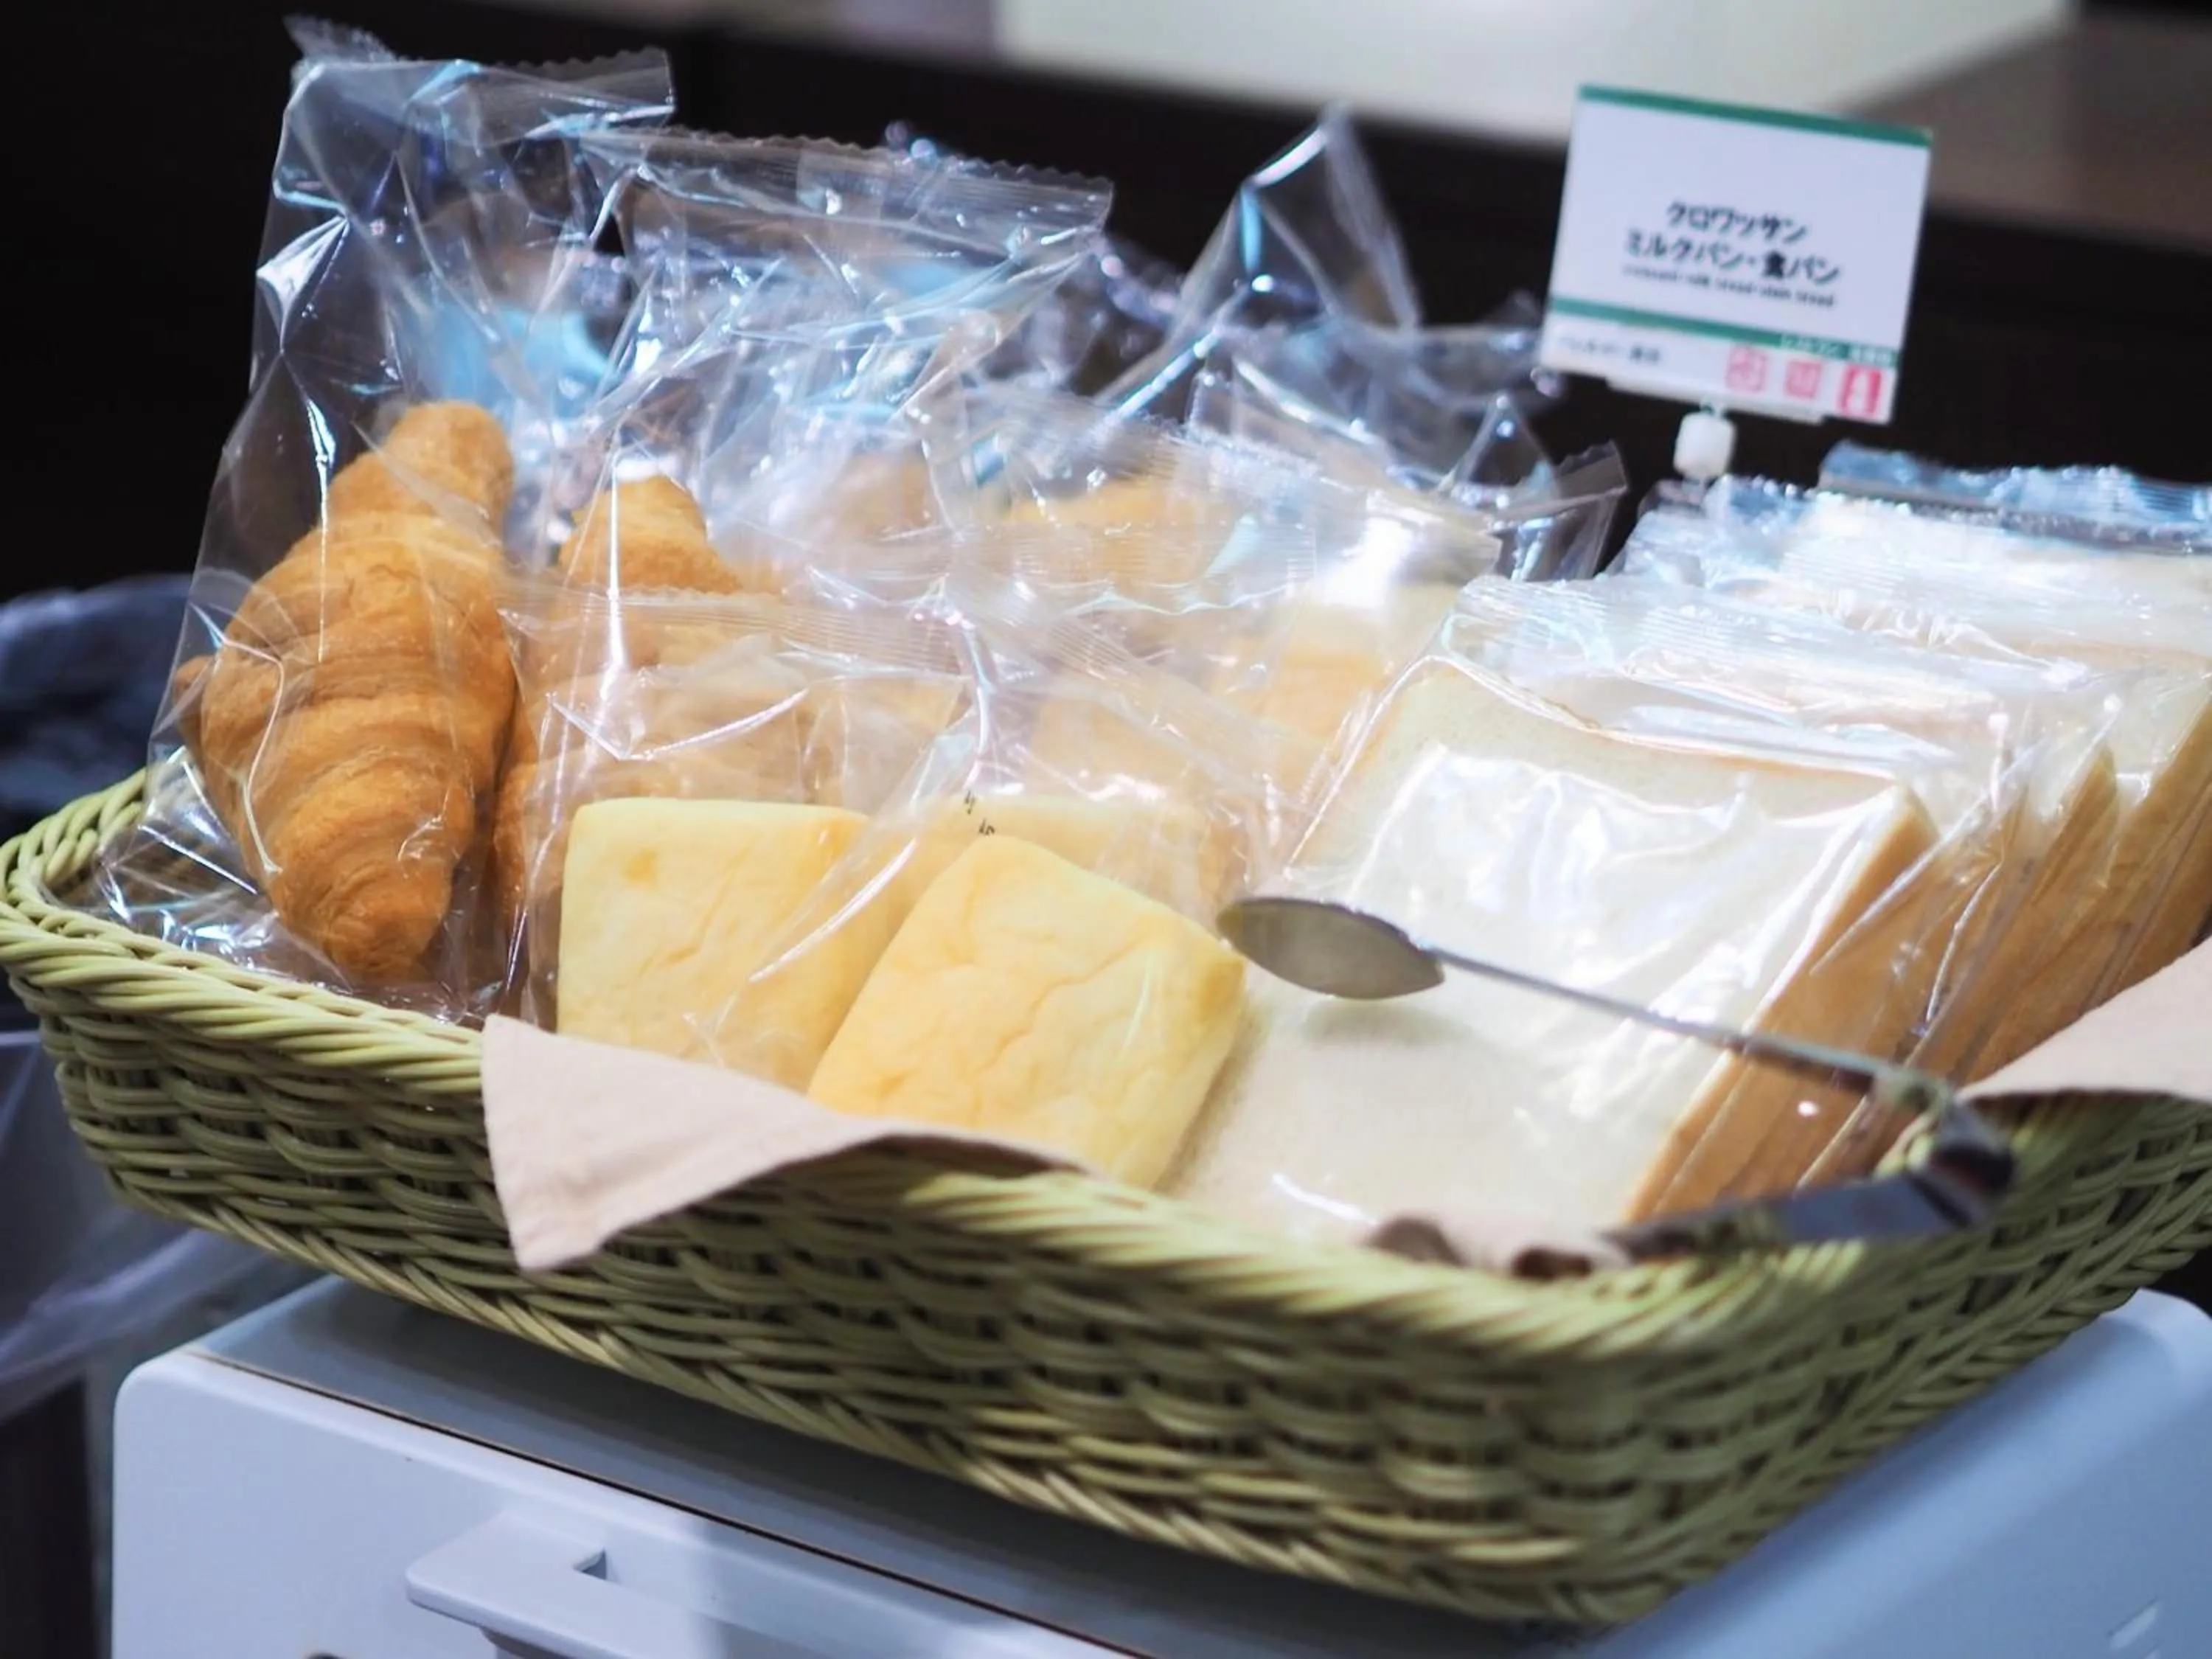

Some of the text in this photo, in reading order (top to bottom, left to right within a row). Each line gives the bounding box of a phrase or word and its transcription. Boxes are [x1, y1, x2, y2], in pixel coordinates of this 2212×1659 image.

[1667, 202, 1806, 243] クロワッサン
